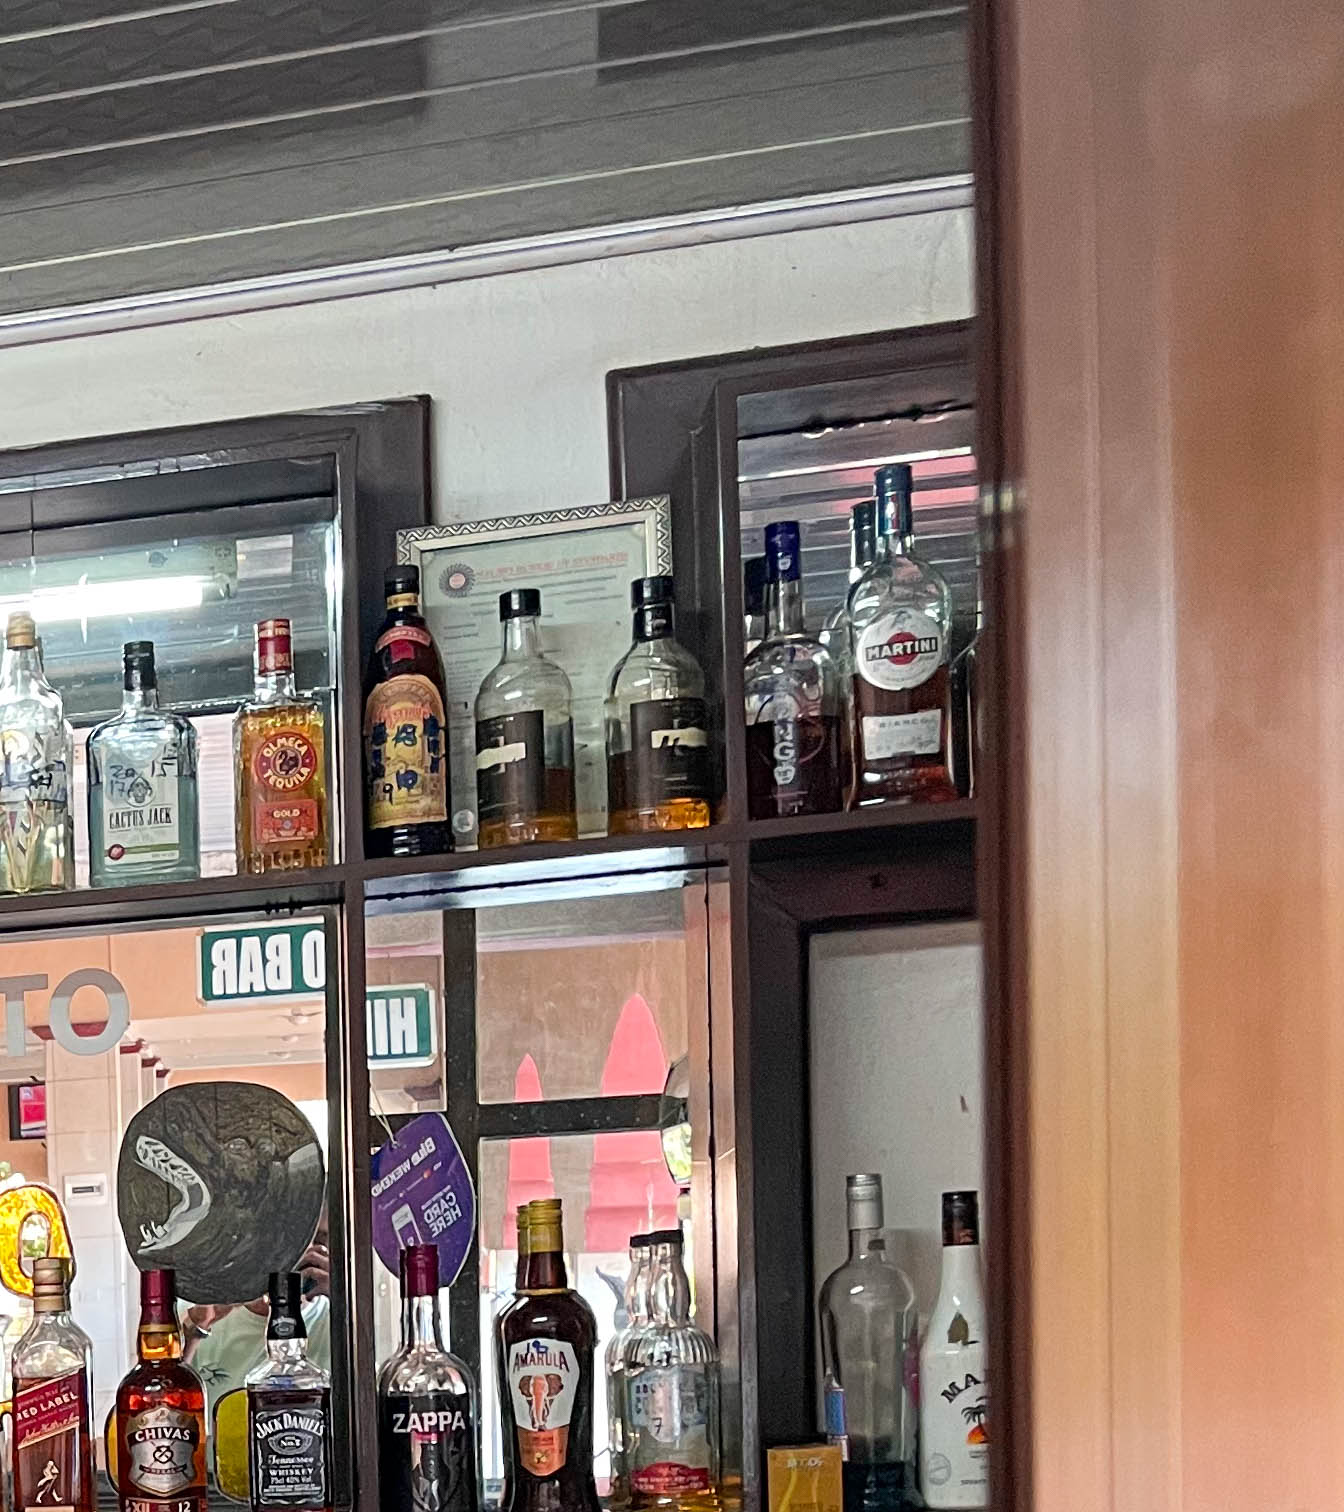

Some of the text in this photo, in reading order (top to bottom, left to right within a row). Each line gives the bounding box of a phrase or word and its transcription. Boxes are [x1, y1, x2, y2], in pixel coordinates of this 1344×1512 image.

[866, 636, 939, 661] MARTINI
[263, 736, 308, 758] OLMECA
[262, 766, 312, 791] TEQUILA
[109, 805, 173, 828] CACTUS JACK
[273, 809, 300, 819] GOLD
[512, 1350, 570, 1375] AMARULA
[40, 1393, 79, 1412] LABEL
[256, 1413, 326, 1439] JACK DANIEL'S
[393, 1411, 466, 1434] ZAPPA
[135, 1428, 191, 1442] CHIVAS
[269, 1467, 315, 1477] WHISKEY
